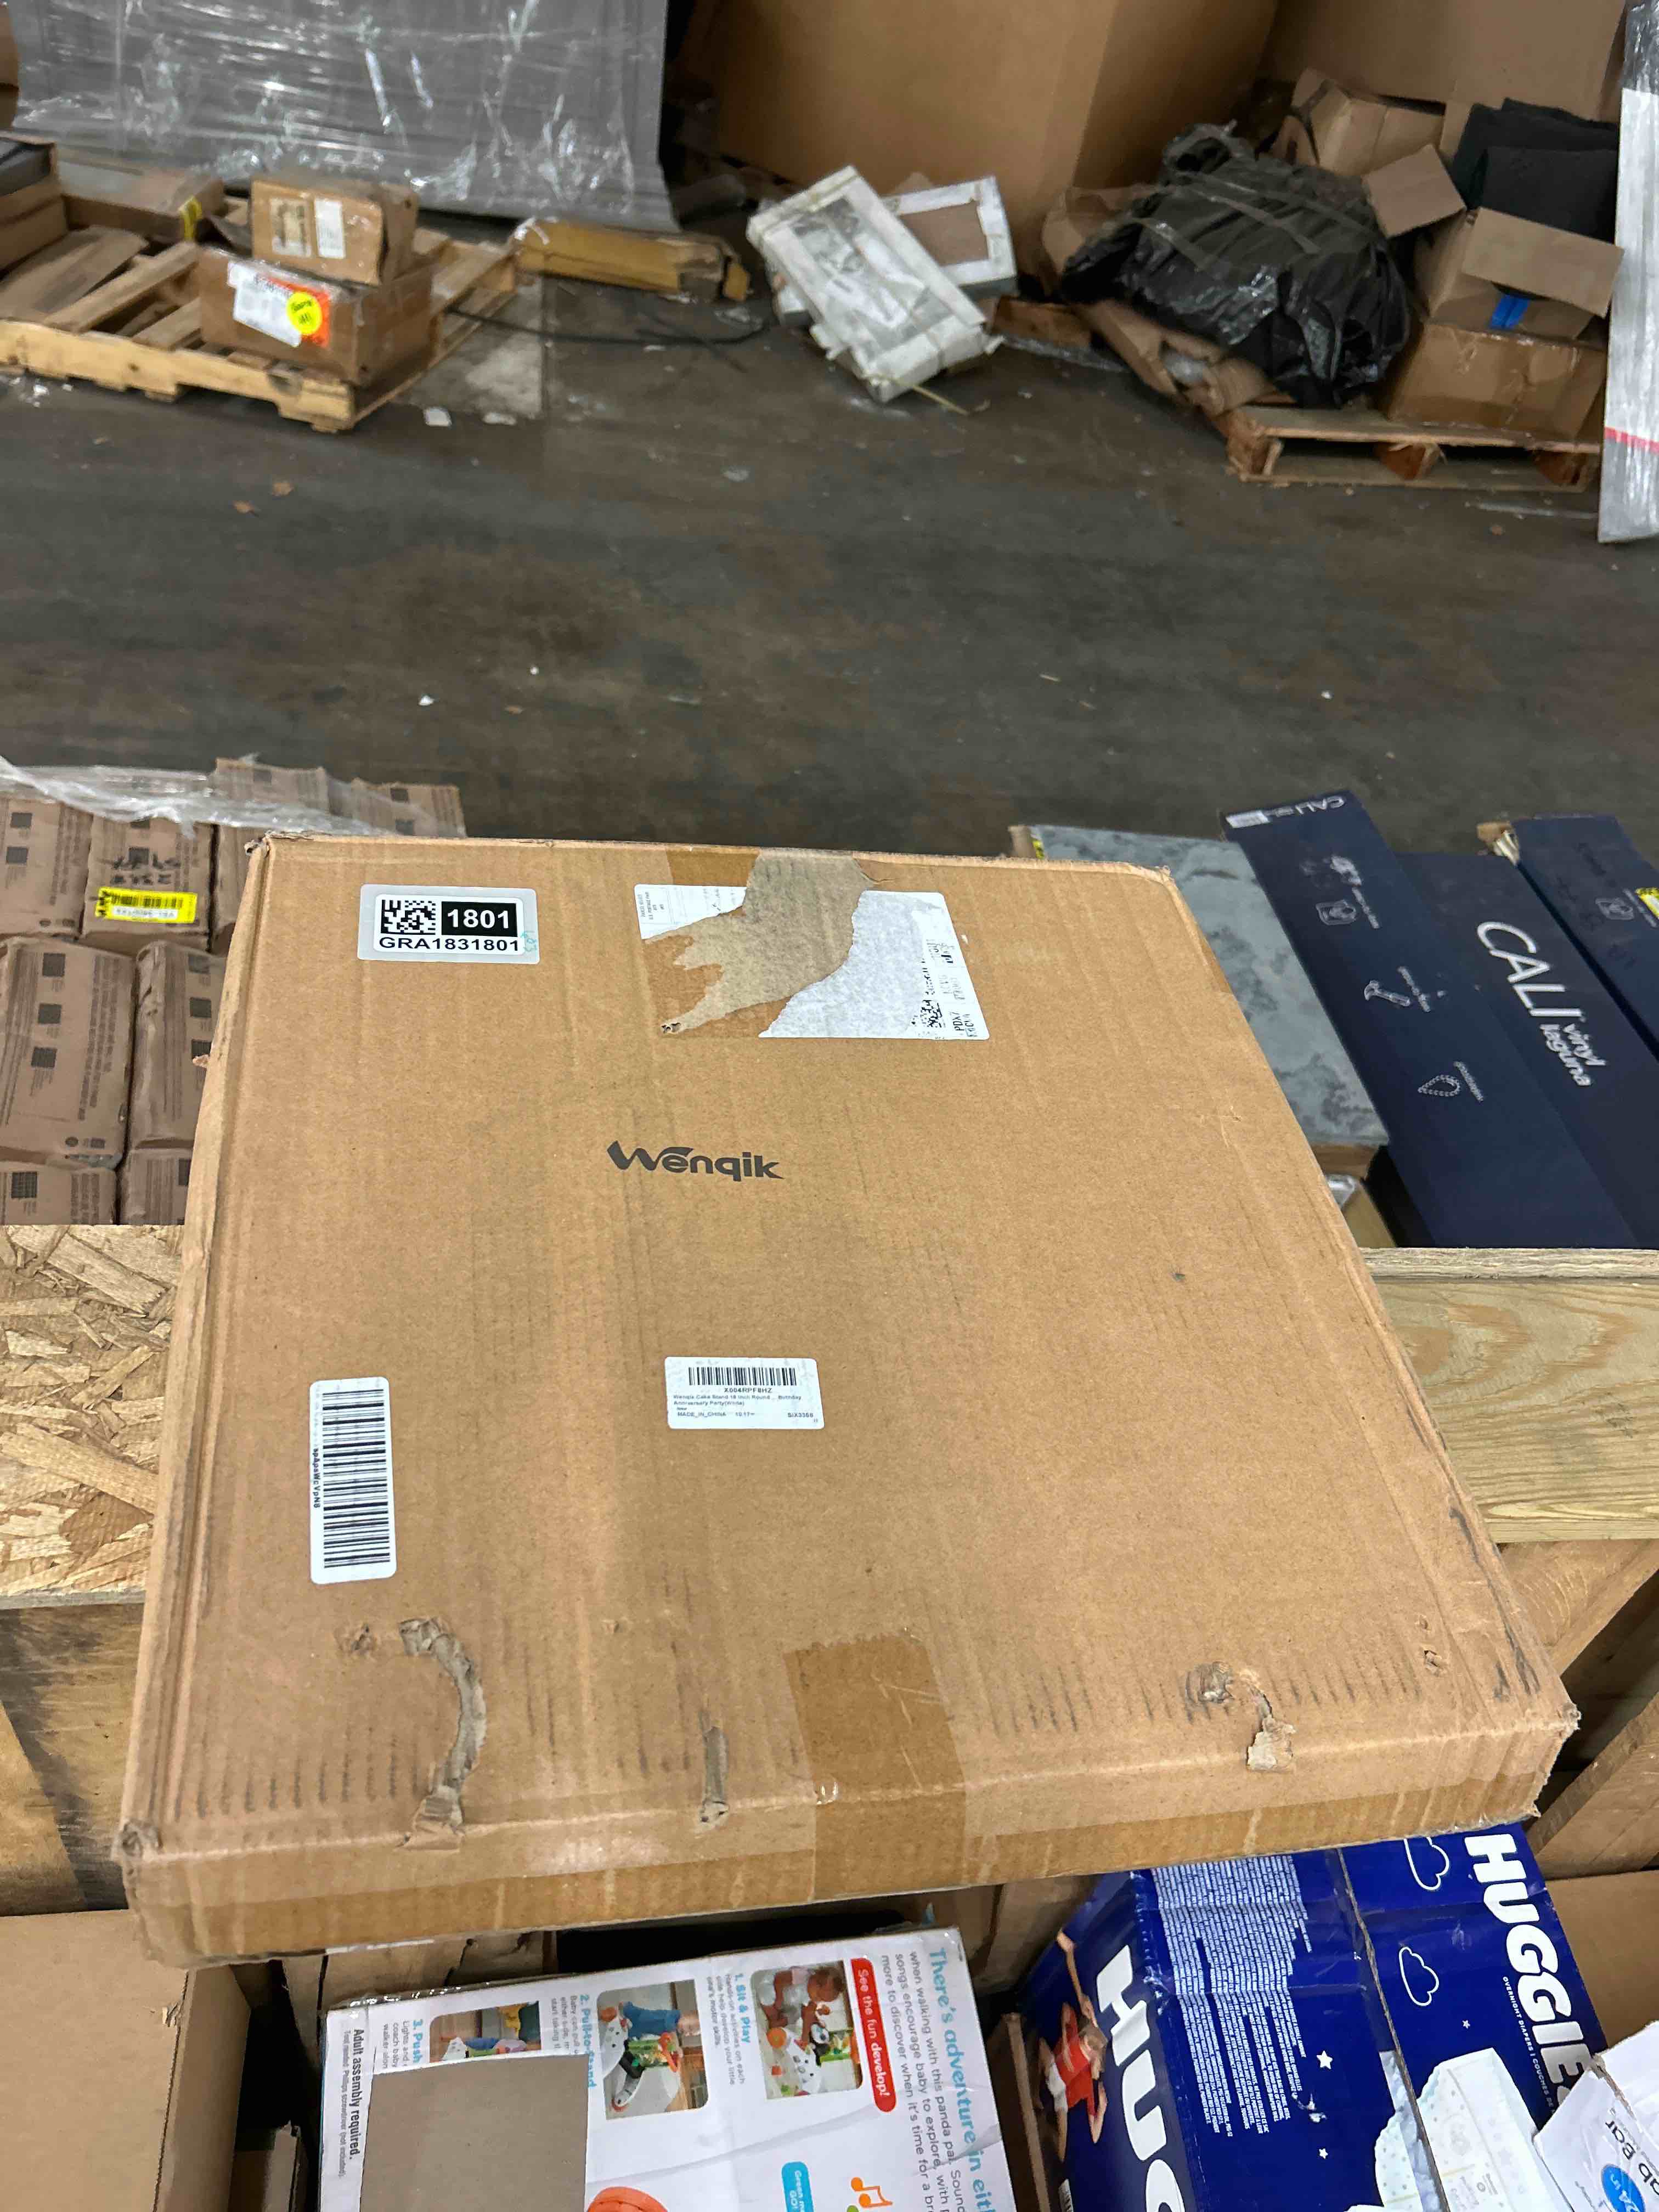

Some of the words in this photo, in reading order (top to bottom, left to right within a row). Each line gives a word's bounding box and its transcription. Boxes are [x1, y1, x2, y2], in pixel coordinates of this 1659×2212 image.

[447, 909, 509, 929] 1801
[379, 936, 518, 951] GRA1831801
[1477, 922, 1582, 1017] CALI
[1563, 1024, 1606, 1065] vinyl
[607, 1141, 784, 1181] Wenqik
[855, 1968, 872, 1993] See
[880, 1954, 892, 1987] more
[892, 1953, 908, 1990] songs
[909, 1951, 922, 1984] when
[1464, 1833, 1594, 2106] HUGGIE
[735, 1984, 748, 2002] Sit
[885, 1989, 898, 2004] to
[929, 1948, 953, 2023] There's
[861, 1995, 876, 2016] the
[915, 1987, 932, 2035] walking
[1502, 1976, 1522, 2018] OVERNIGHT
[1517, 2019, 1534, 2051] DIAPERS
[353, 2028, 365, 2056] Adult
[738, 2016, 754, 2044] Play
[865, 2018, 881, 2039] fun
[890, 2005, 907, 2059] discover
[900, 1992, 921, 2060] encourage
[926, 2037, 938, 2065] with
[350, 2057, 364, 2108] assembly
[869, 2041, 888, 2098] develop!
[900, 2062, 915, 2098] when
[914, 2061, 929, 2095] baby
[929, 2068, 945, 2092] this
[944, 2029, 977, 2143] adventure
[906, 2101, 921, 2122] it's
[920, 2097, 933, 2113] to
[936, 2095, 951, 2137] panda
[348, 2109, 362, 2160] required.
[912, 2125, 925, 2155] time
[916, 2158, 931, 2181] for
[966, 2149, 987, 2172] in
[921, 2183, 930, 2191] a
[923, 2194, 938, 2212] br
[936, 2174, 949, 2204] with
[971, 2176, 995, 2212] eit
